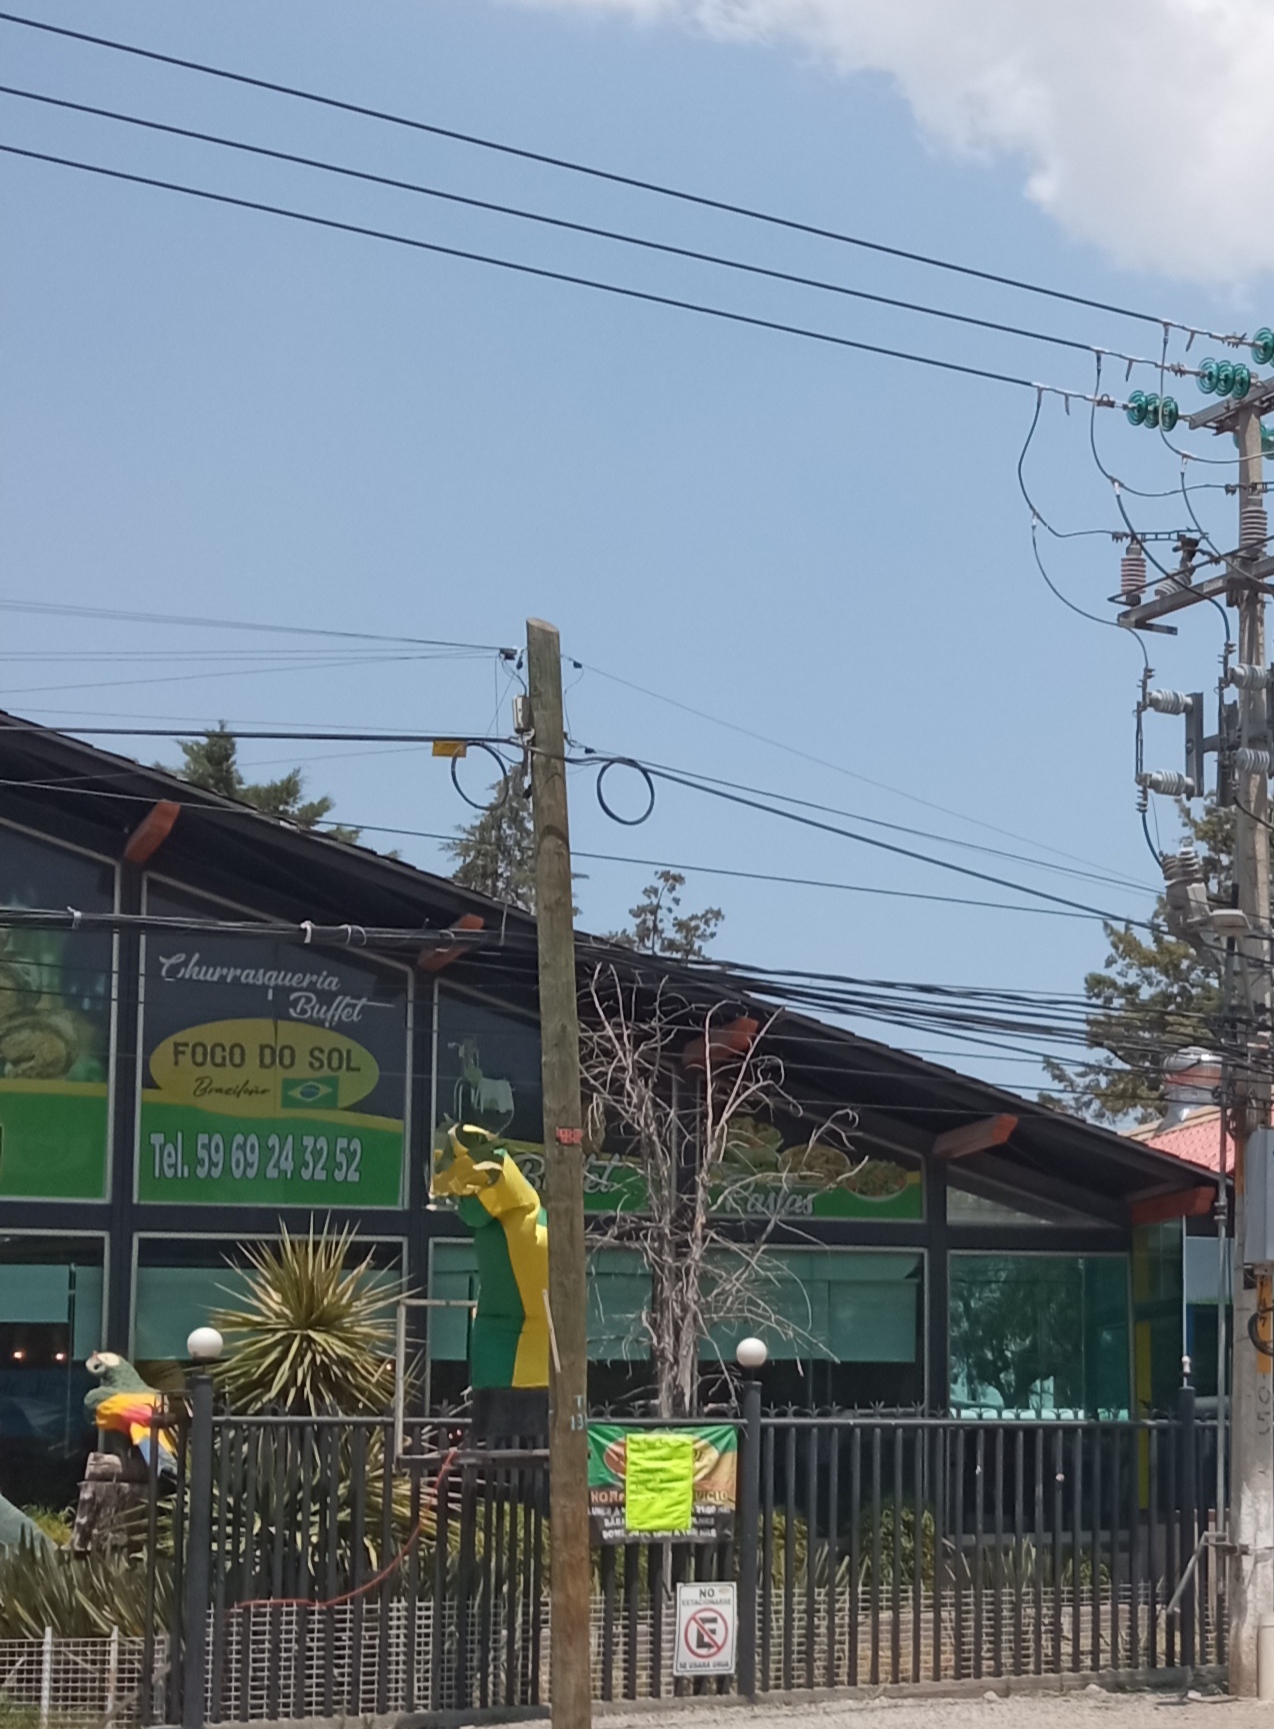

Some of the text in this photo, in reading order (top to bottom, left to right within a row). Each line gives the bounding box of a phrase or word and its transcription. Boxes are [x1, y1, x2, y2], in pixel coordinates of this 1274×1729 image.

[289, 991, 396, 1028] Buffet
[173, 1041, 361, 1073] FOGO DO SOL
[150, 1130, 362, 1182] Tel. 59 69 24 32 52
[699, 1588, 715, 1598] NO
